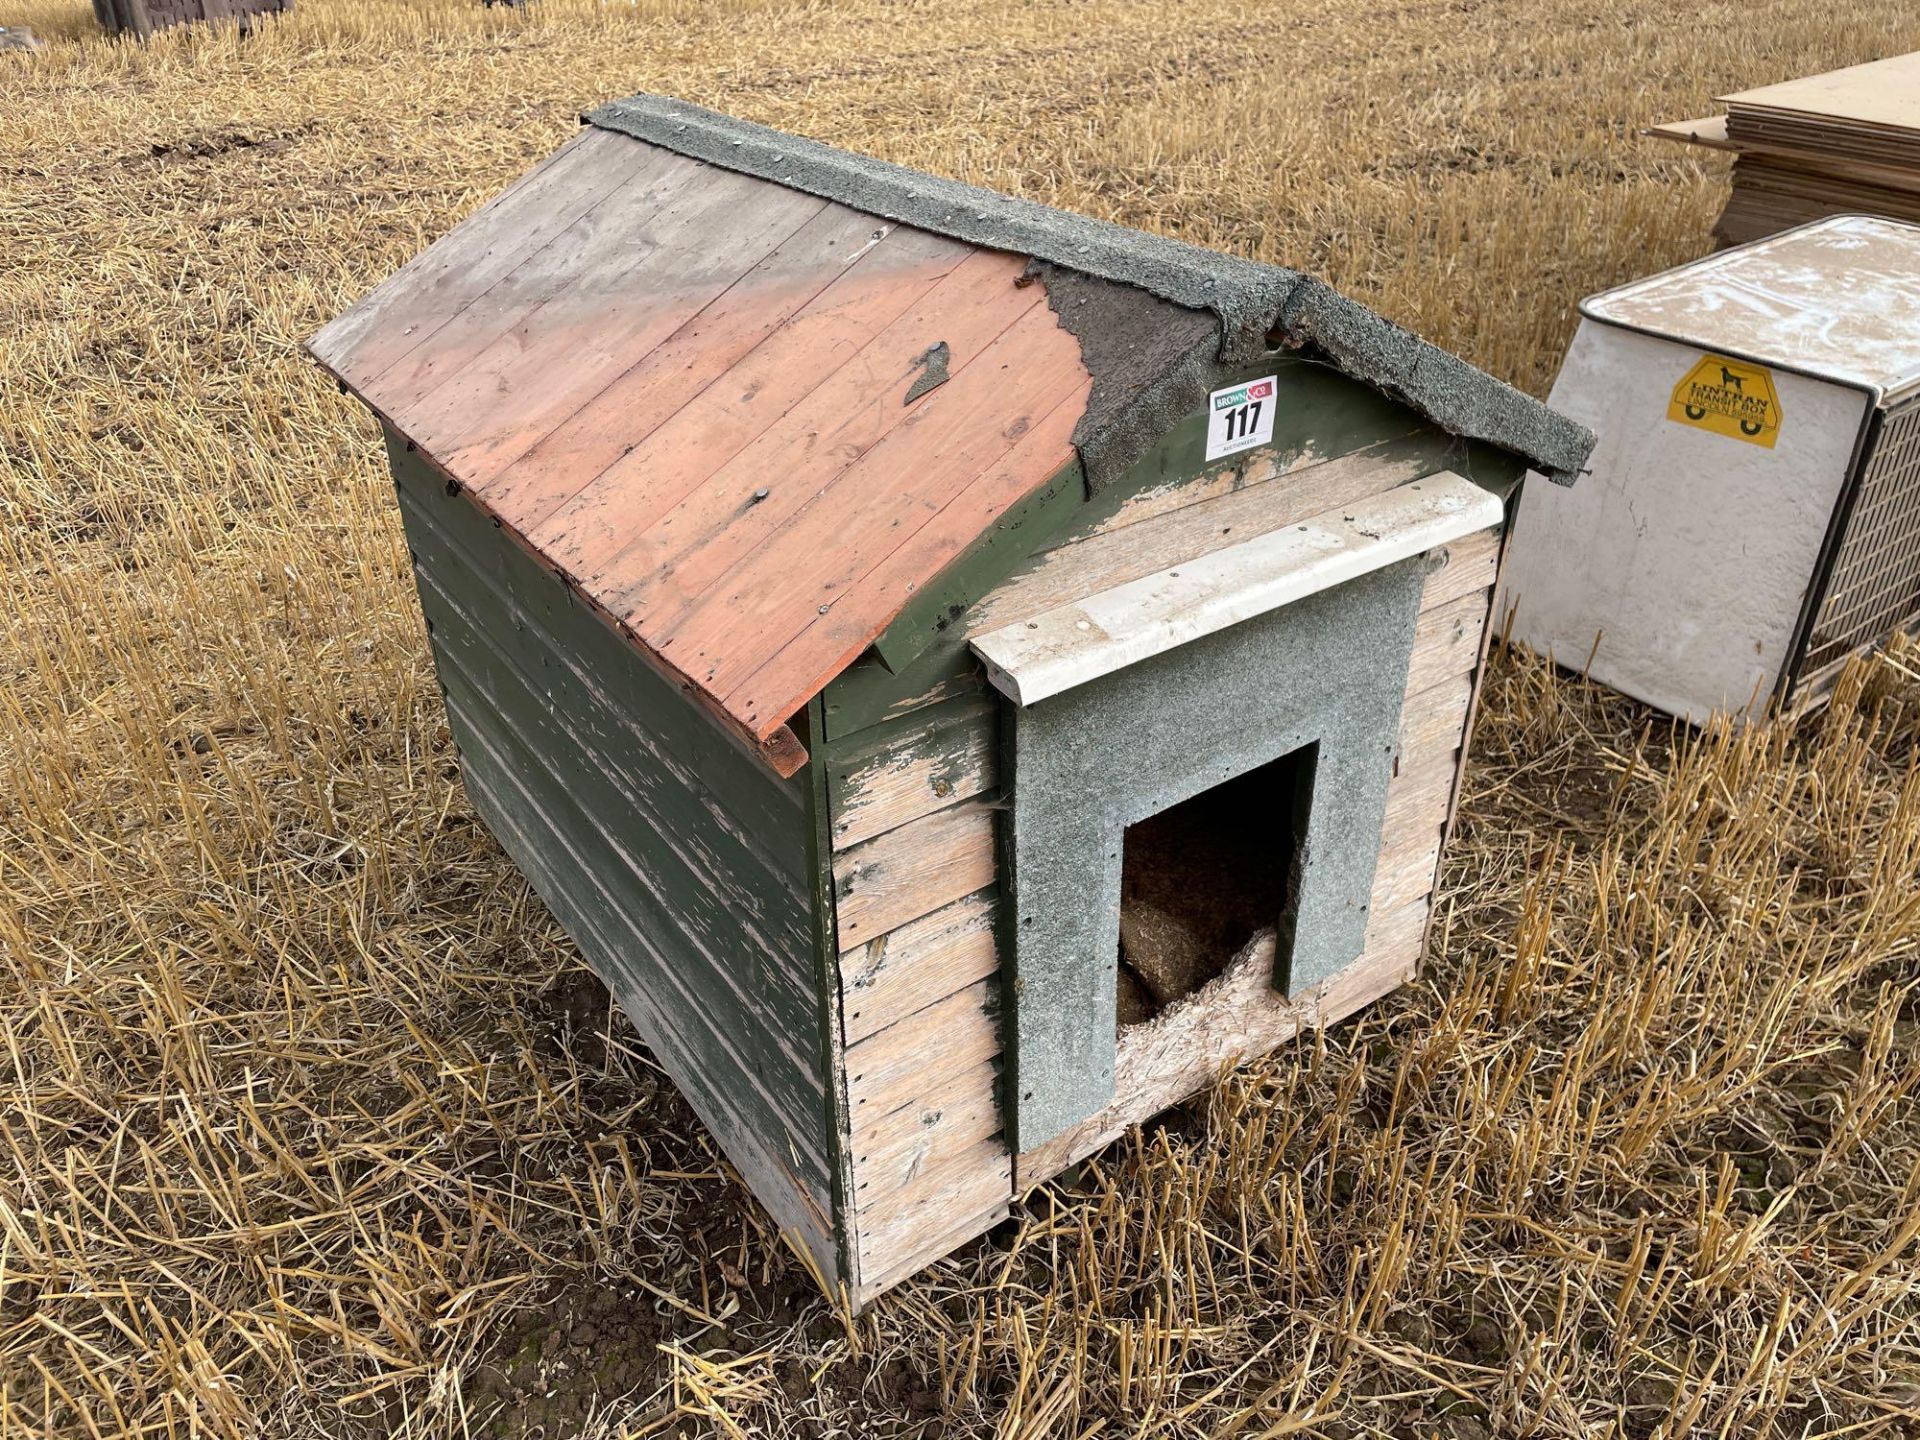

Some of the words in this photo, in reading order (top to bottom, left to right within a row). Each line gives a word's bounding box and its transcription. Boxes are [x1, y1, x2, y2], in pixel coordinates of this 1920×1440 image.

[1689, 388, 1737, 409] TRANSIT
[1741, 401, 1766, 416] BOX
[1691, 382, 1768, 408] LINTRAN
[1224, 400, 1262, 442] 117
